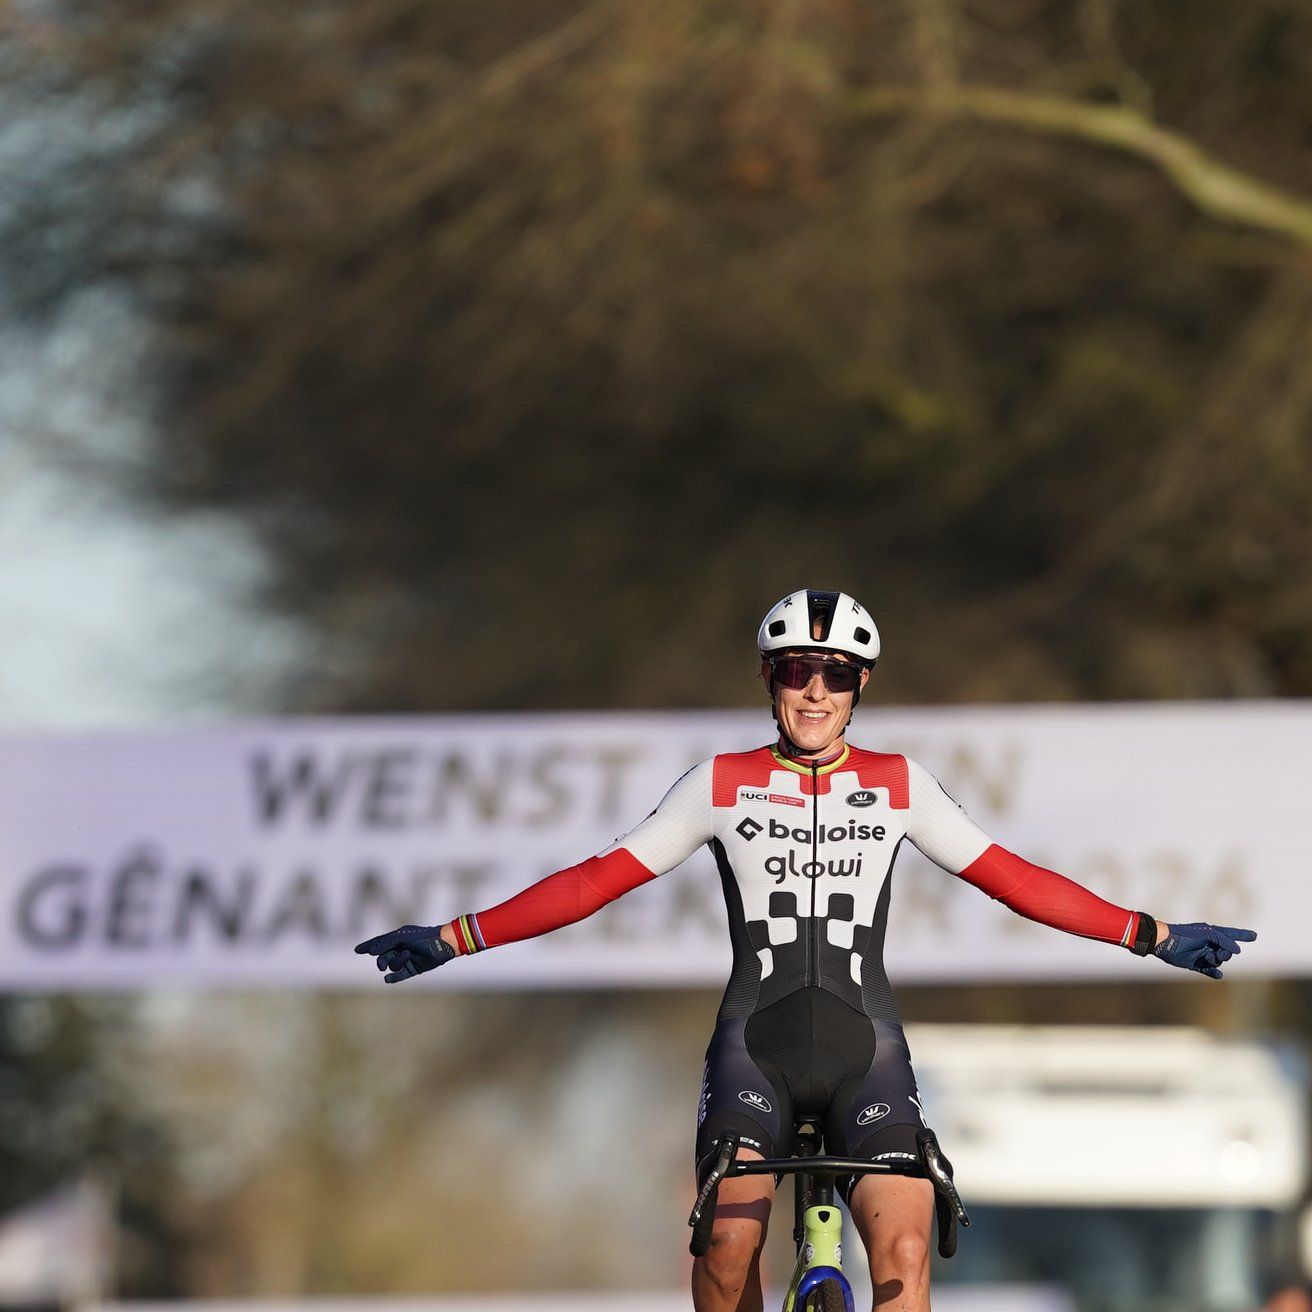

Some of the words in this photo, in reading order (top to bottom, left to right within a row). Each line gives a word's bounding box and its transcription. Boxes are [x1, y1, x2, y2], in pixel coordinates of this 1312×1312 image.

[745, 792, 768, 801] UCI
[769, 818, 886, 844] baloise
[764, 849, 862, 884] glowi
